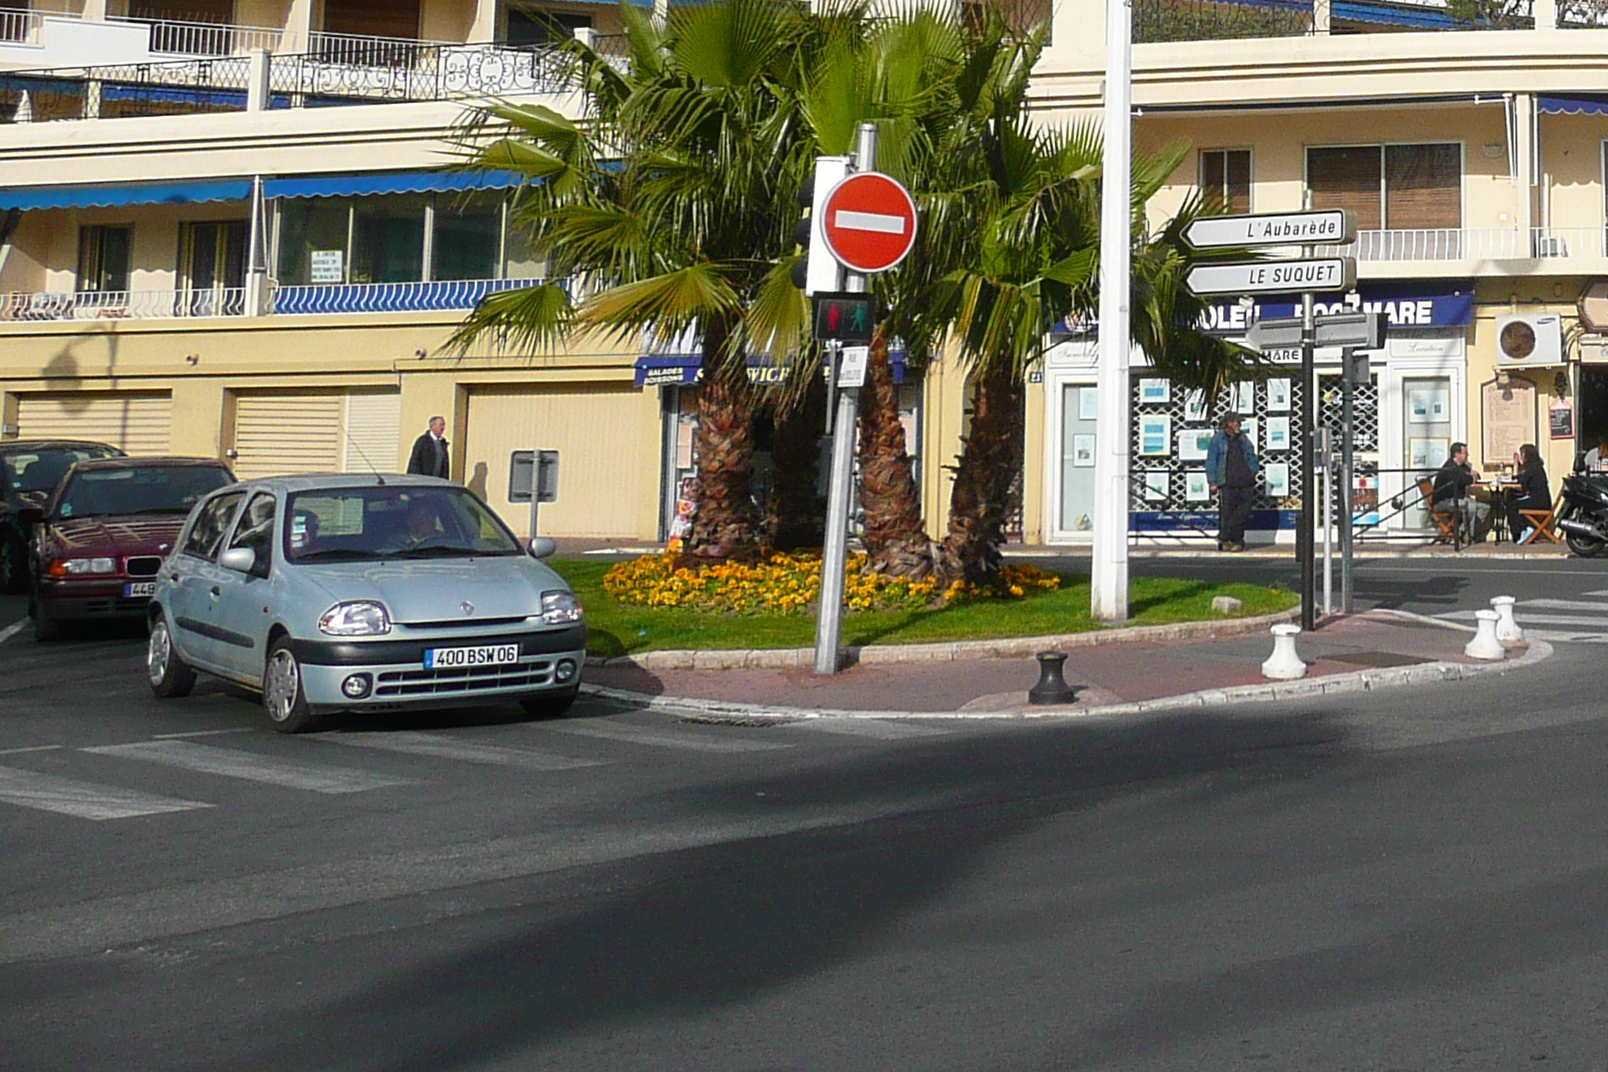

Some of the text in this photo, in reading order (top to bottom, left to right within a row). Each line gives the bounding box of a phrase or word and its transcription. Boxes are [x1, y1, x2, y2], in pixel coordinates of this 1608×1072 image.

[1247, 219, 1336, 238] L'Aubarède
[1249, 265, 1336, 284] LE SUQUET
[436, 646, 516, 666] 400 BSW 06
